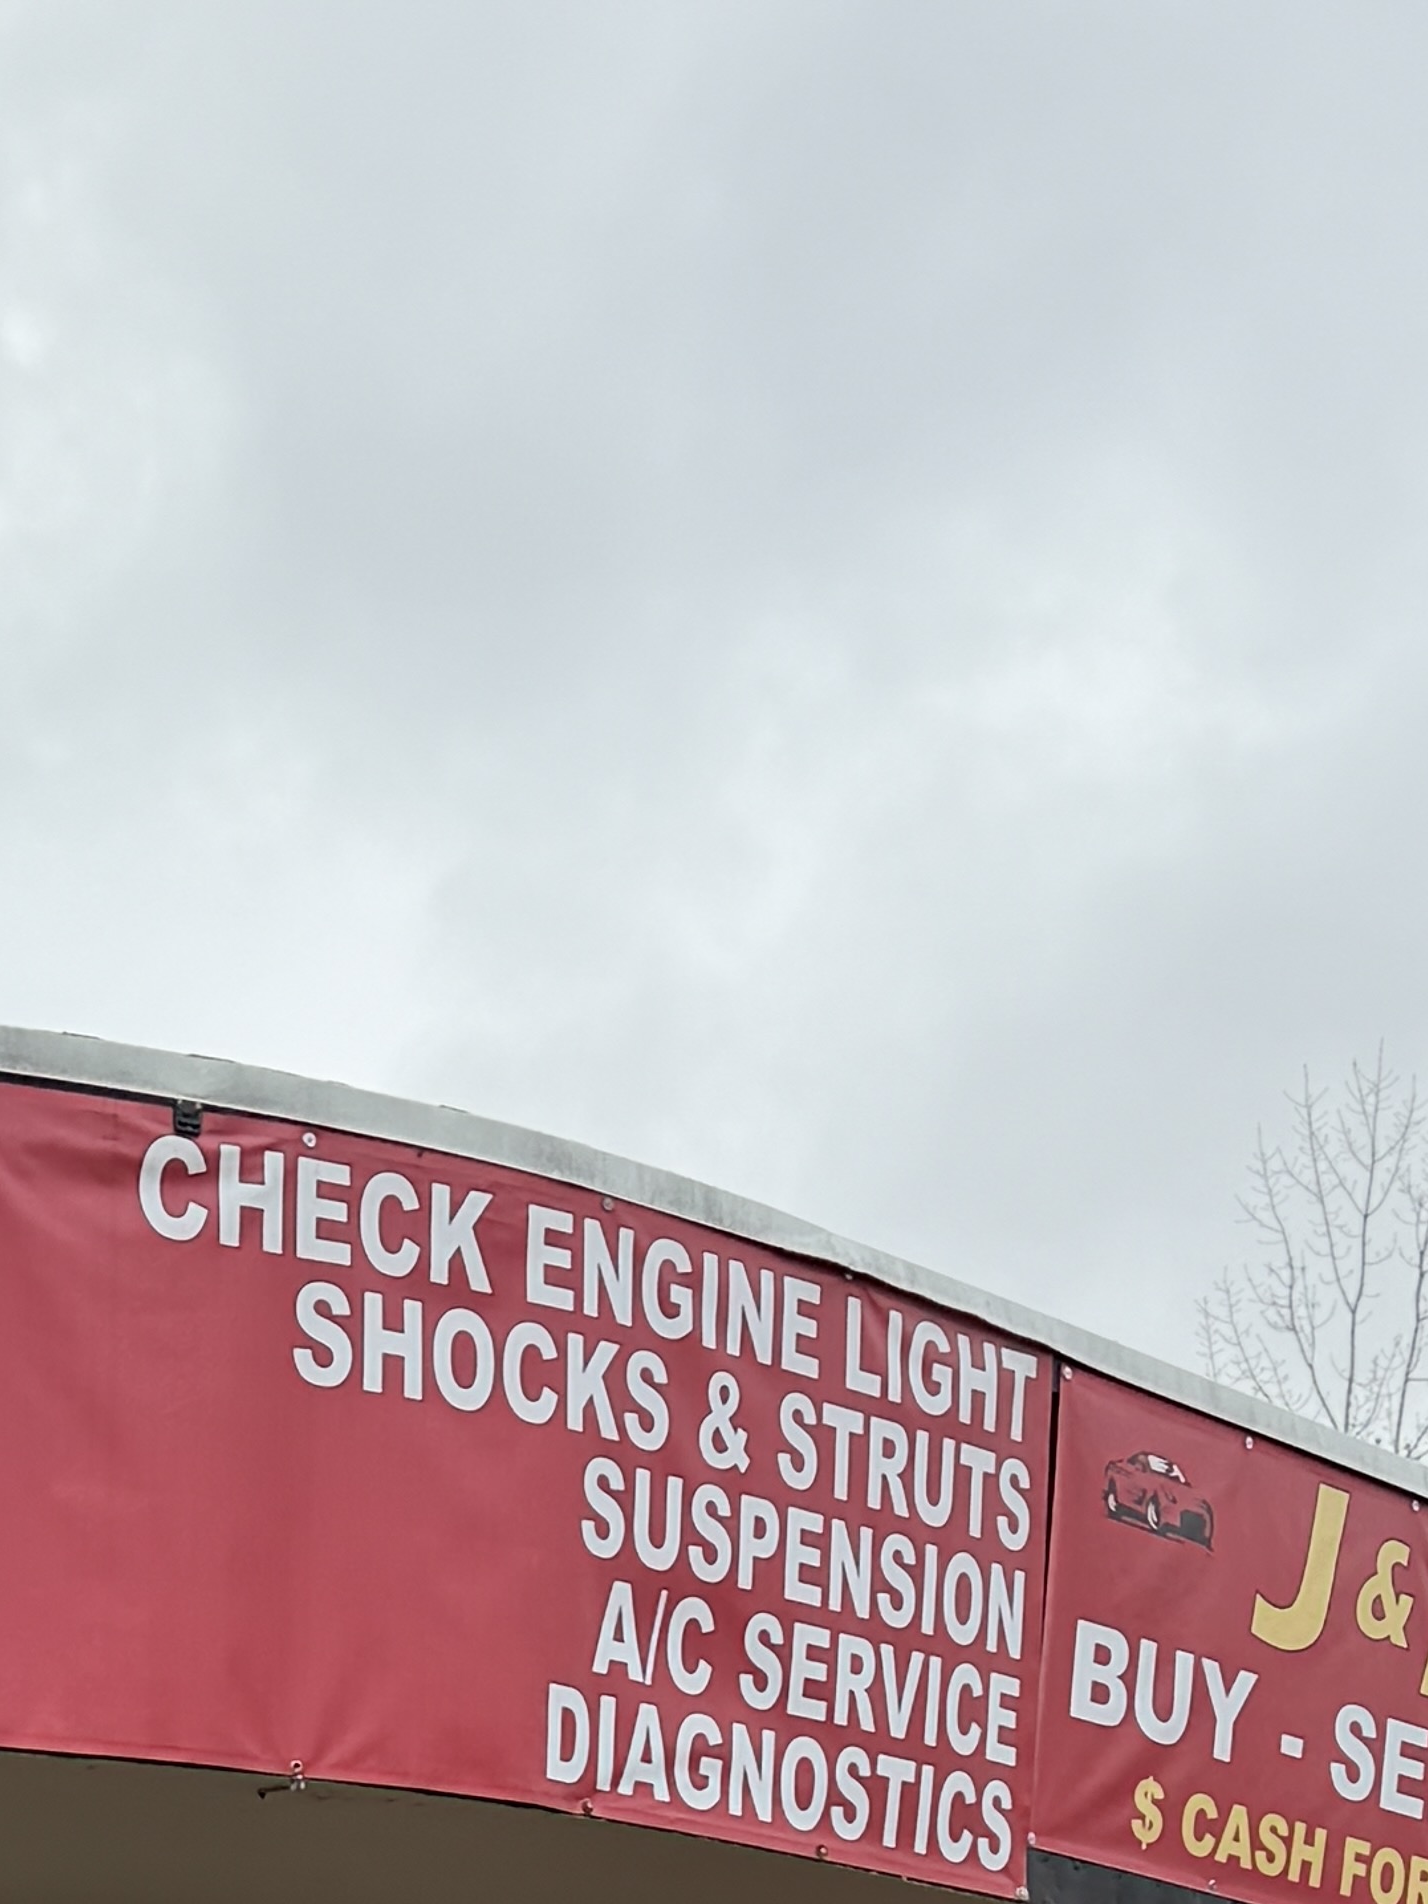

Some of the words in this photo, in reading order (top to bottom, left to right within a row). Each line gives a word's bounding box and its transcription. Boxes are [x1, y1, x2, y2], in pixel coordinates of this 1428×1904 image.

[138, 1135, 493, 1295] CHECK
[525, 1203, 822, 1378] ENGINE
[844, 1295, 1038, 1444] LIGHT
[293, 1281, 669, 1452] SHOCKS
[699, 1371, 751, 1473] &
[777, 1393, 1032, 1551] STRUTS
[581, 1456, 1026, 1659] SUSPENSION
[592, 1578, 714, 1697] A/C
[739, 1614, 1020, 1767] SERVICE
[1070, 1620, 1258, 1762] BUY
[1281, 1733, 1304, 1757] -
[546, 1683, 1013, 1871] DIAGNOSTICS
[1132, 1776, 1163, 1850] $
[1182, 1794, 1326, 1888] CASH
